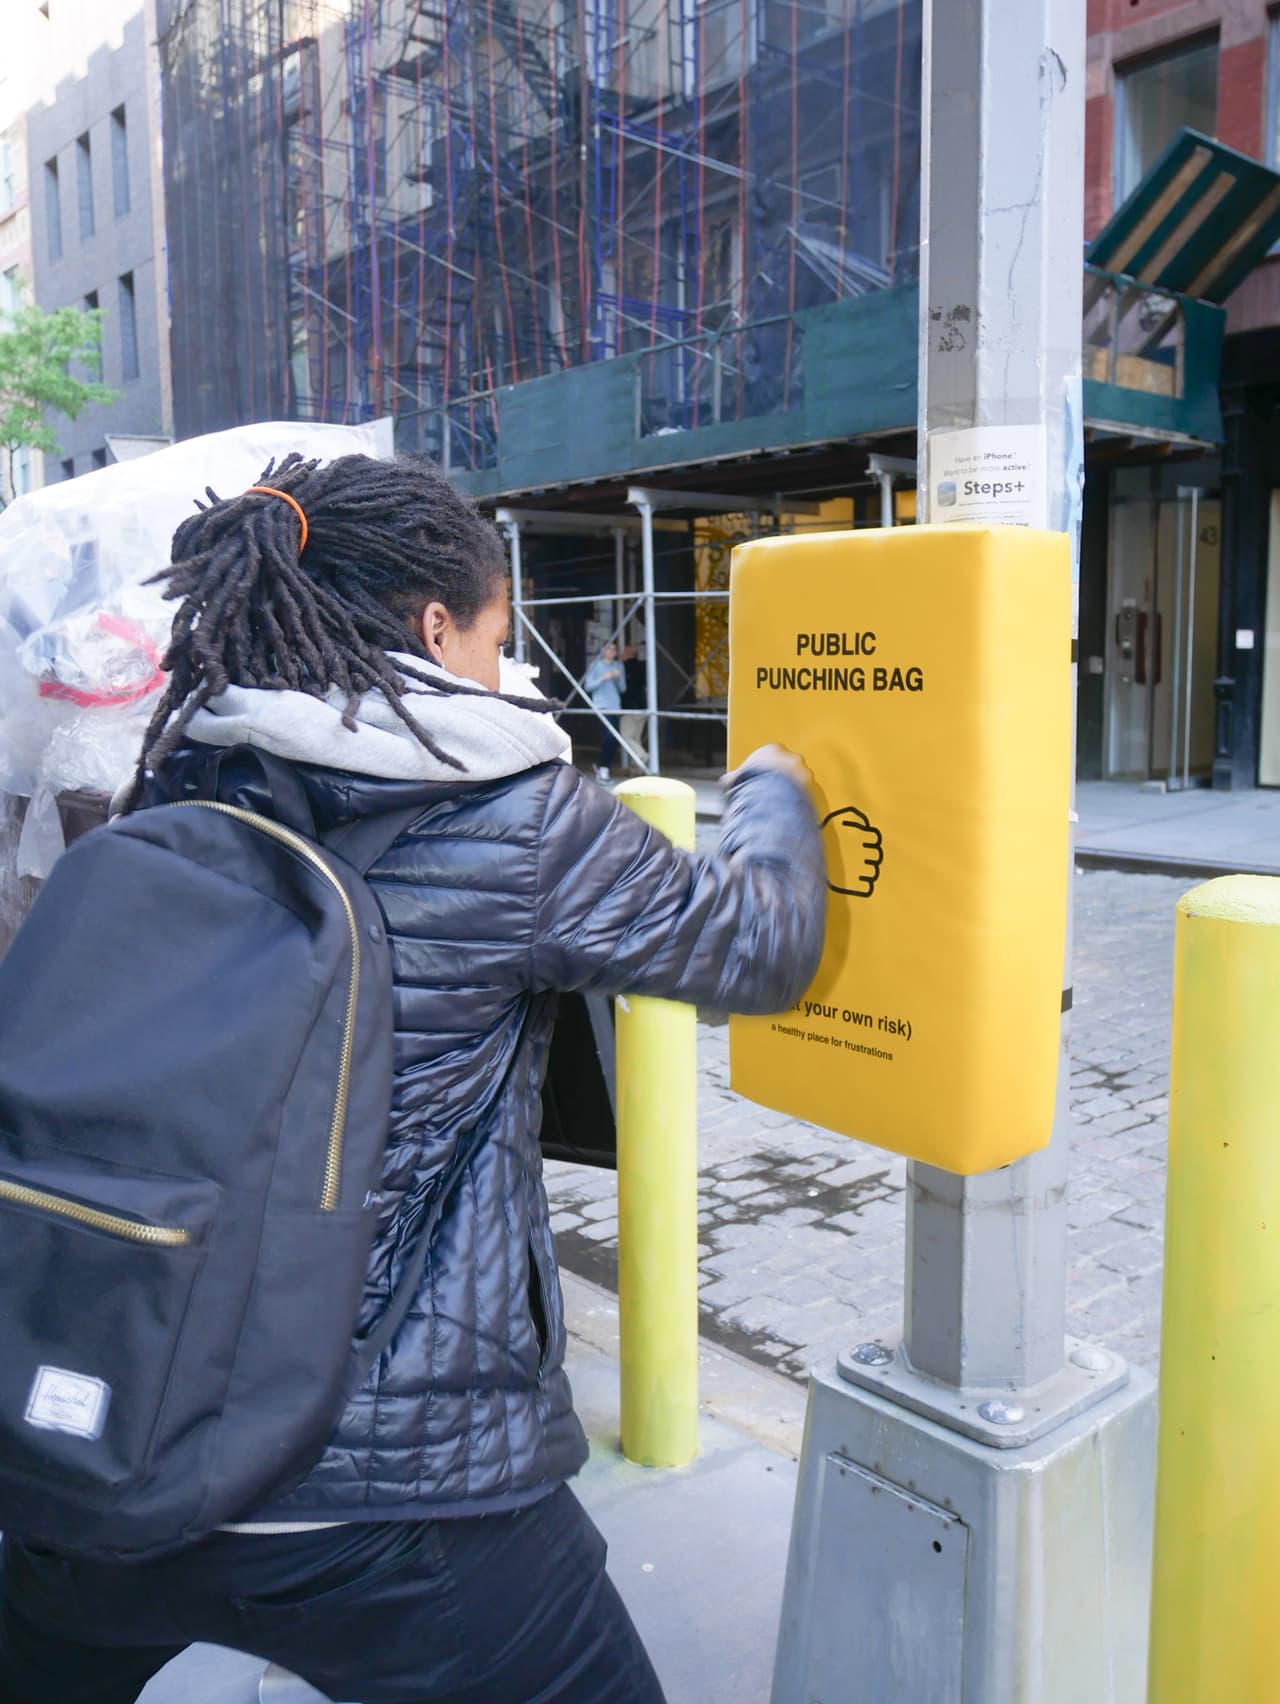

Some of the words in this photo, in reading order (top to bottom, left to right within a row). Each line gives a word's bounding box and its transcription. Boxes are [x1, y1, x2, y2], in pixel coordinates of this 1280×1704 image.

[963, 480, 1025, 498] Steps+
[796, 631, 876, 656] PUBLIC
[756, 667, 866, 692] PUNCHING
[872, 666, 924, 692] BAG
[804, 1000, 838, 1019] your
[842, 1009, 873, 1028] own
[878, 1015, 912, 1041] risk)
[771, 1023, 777, 1031] a
[777, 1024, 805, 1041] healthy
[807, 1031, 829, 1045] place
[831, 1036, 843, 1048] for
[844, 1039, 894, 1062] frustrations
